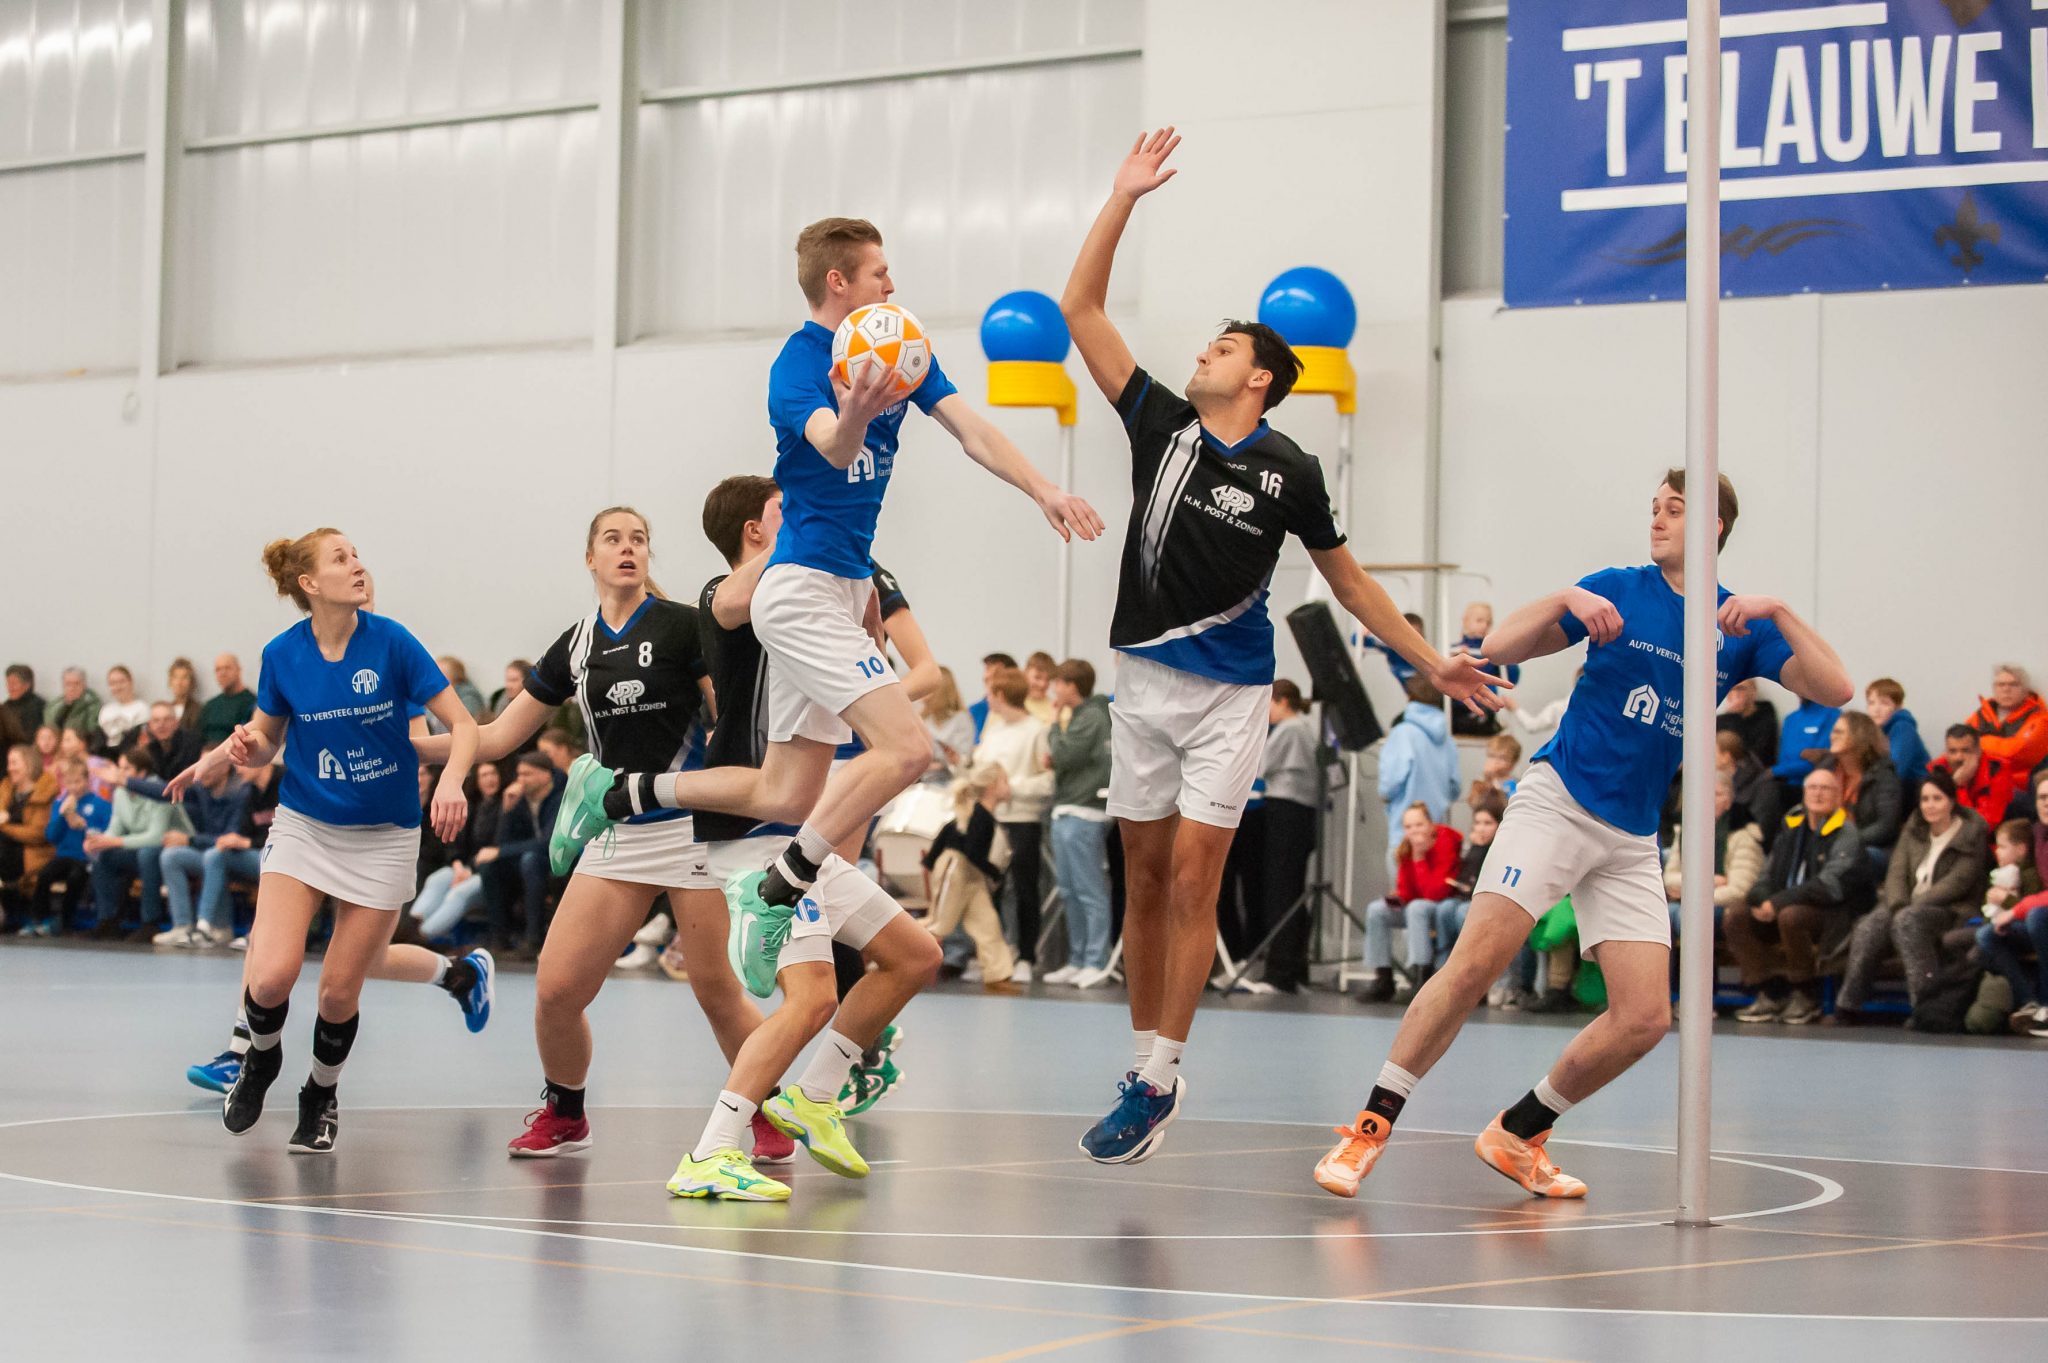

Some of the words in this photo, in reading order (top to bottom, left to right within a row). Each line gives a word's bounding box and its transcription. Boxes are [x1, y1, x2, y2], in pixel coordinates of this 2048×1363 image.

[1259, 469, 1283, 499] 16
[1183, 494, 1202, 510] H.N.
[1204, 505, 1228, 520] POST
[1226, 516, 1234, 524] &
[1234, 519, 1263, 537] ZONEN
[638, 641, 653, 667] 8
[1628, 639, 1654, 653] AUTO
[855, 656, 885, 679] 10
[313, 708, 353, 722] VERSTEEG
[353, 700, 394, 716] BUURMAN
[611, 706, 630, 716] POST
[630, 705, 638, 713] &
[638, 701, 667, 712] ZONEN
[346, 747, 365, 760] Hul
[349, 757, 383, 772] Luigjes
[351, 763, 399, 783] Hardeveld
[1502, 865, 1522, 888] 11
